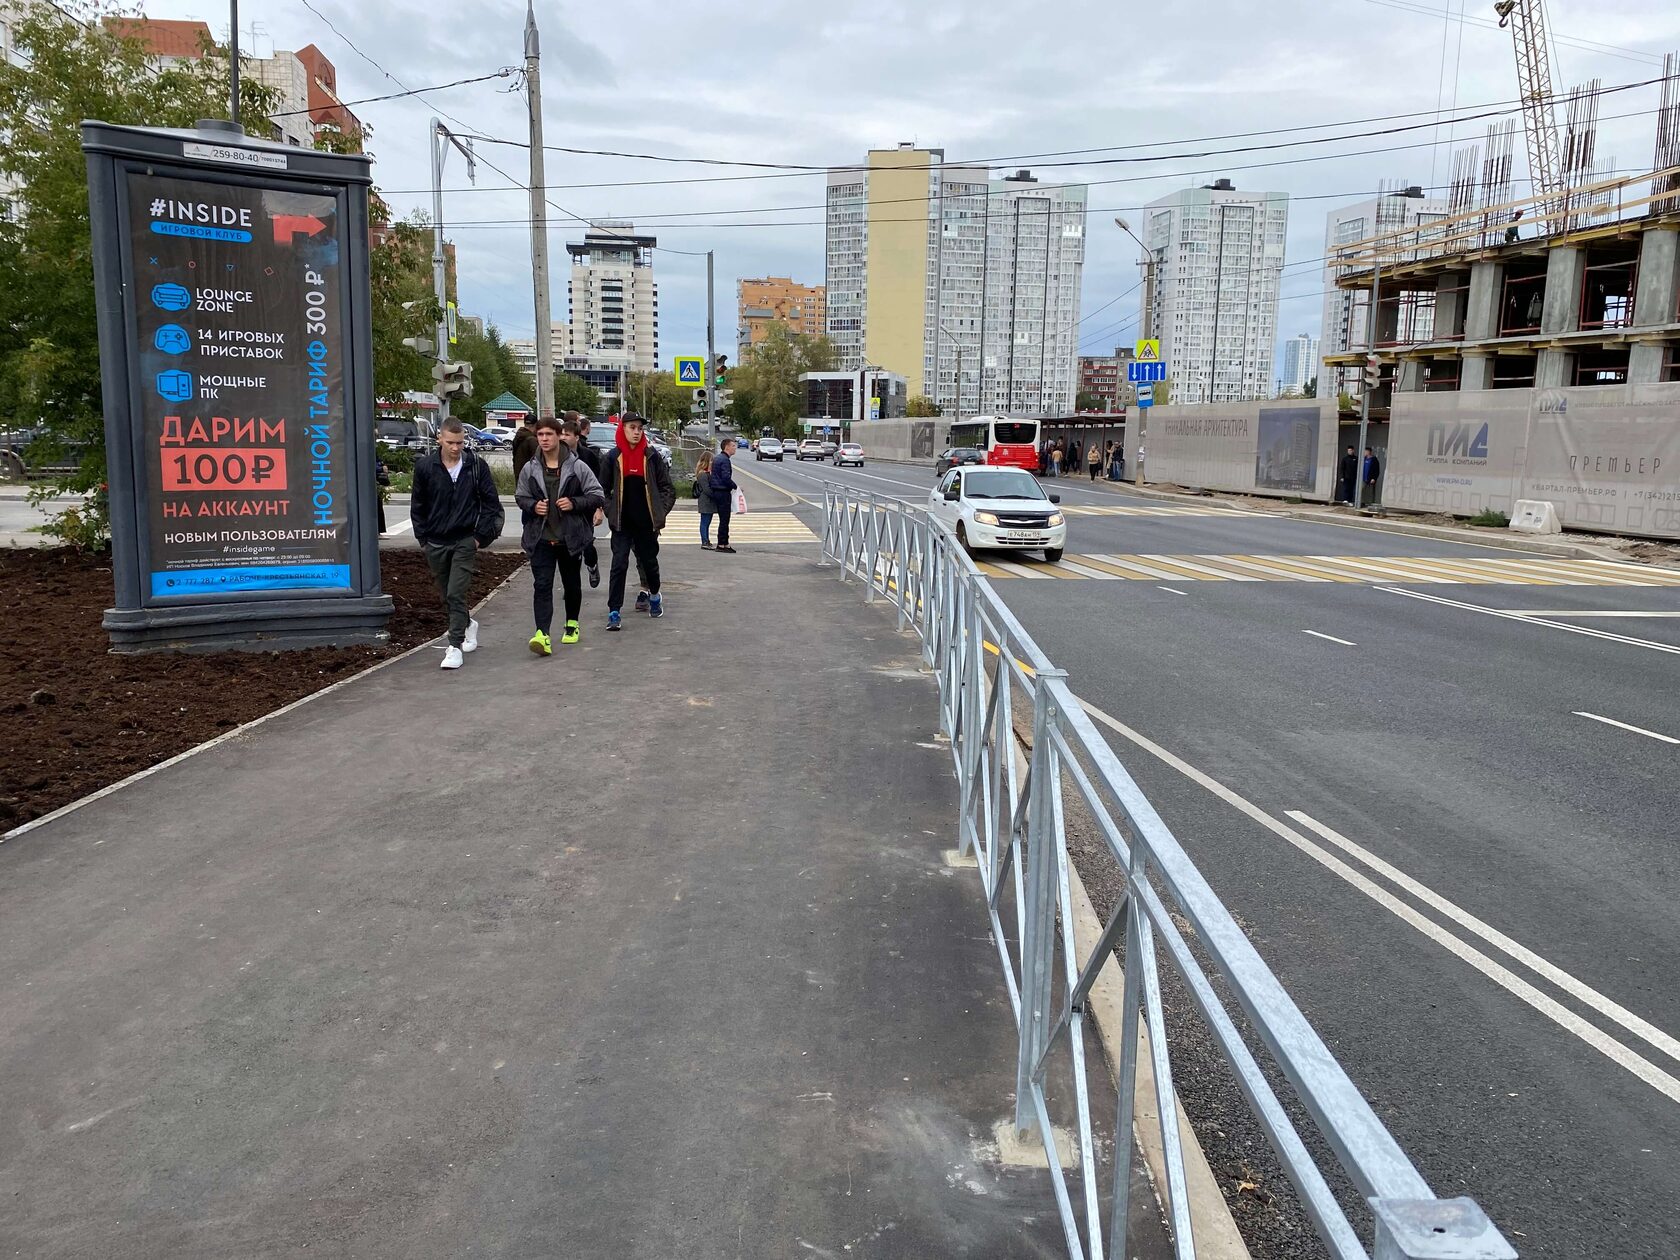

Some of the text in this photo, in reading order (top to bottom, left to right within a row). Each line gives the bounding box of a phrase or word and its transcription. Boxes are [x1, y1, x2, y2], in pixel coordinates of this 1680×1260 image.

[213, 149, 259, 163] 259-80-40
[150, 198, 252, 228] #INSIDE
[160, 224, 243, 240] ИГРОВОЙ КЛУБ
[196, 288, 253, 303] LOUNGE
[196, 300, 234, 313] ZONE
[305, 291, 327, 336] 300
[197, 328, 285, 344] 14 ИГРОВЫХ
[200, 345, 284, 360] ПРИСТАВОК
[200, 375, 267, 388] МОЩНЫЕ
[307, 340, 329, 419] ТАРИФ
[200, 388, 219, 399] ПК
[159, 416, 286, 446] ДАРИМ
[1203, 418, 1248, 437] АРХИТЕКТУРА
[173, 454, 275, 485] 100₽
[1452, 458, 1487, 467] КОМПАНИЙ
[1569, 455, 1661, 475] ПРЕМЬЕР
[304, 425, 333, 526] НОЧНОЙ
[163, 500, 290, 518] НА АККАУНТ
[164, 528, 337, 544] НОВЫМ ПОЛЬЗОВАТЕЛЯМ
[222, 545, 276, 555] #insidegame
